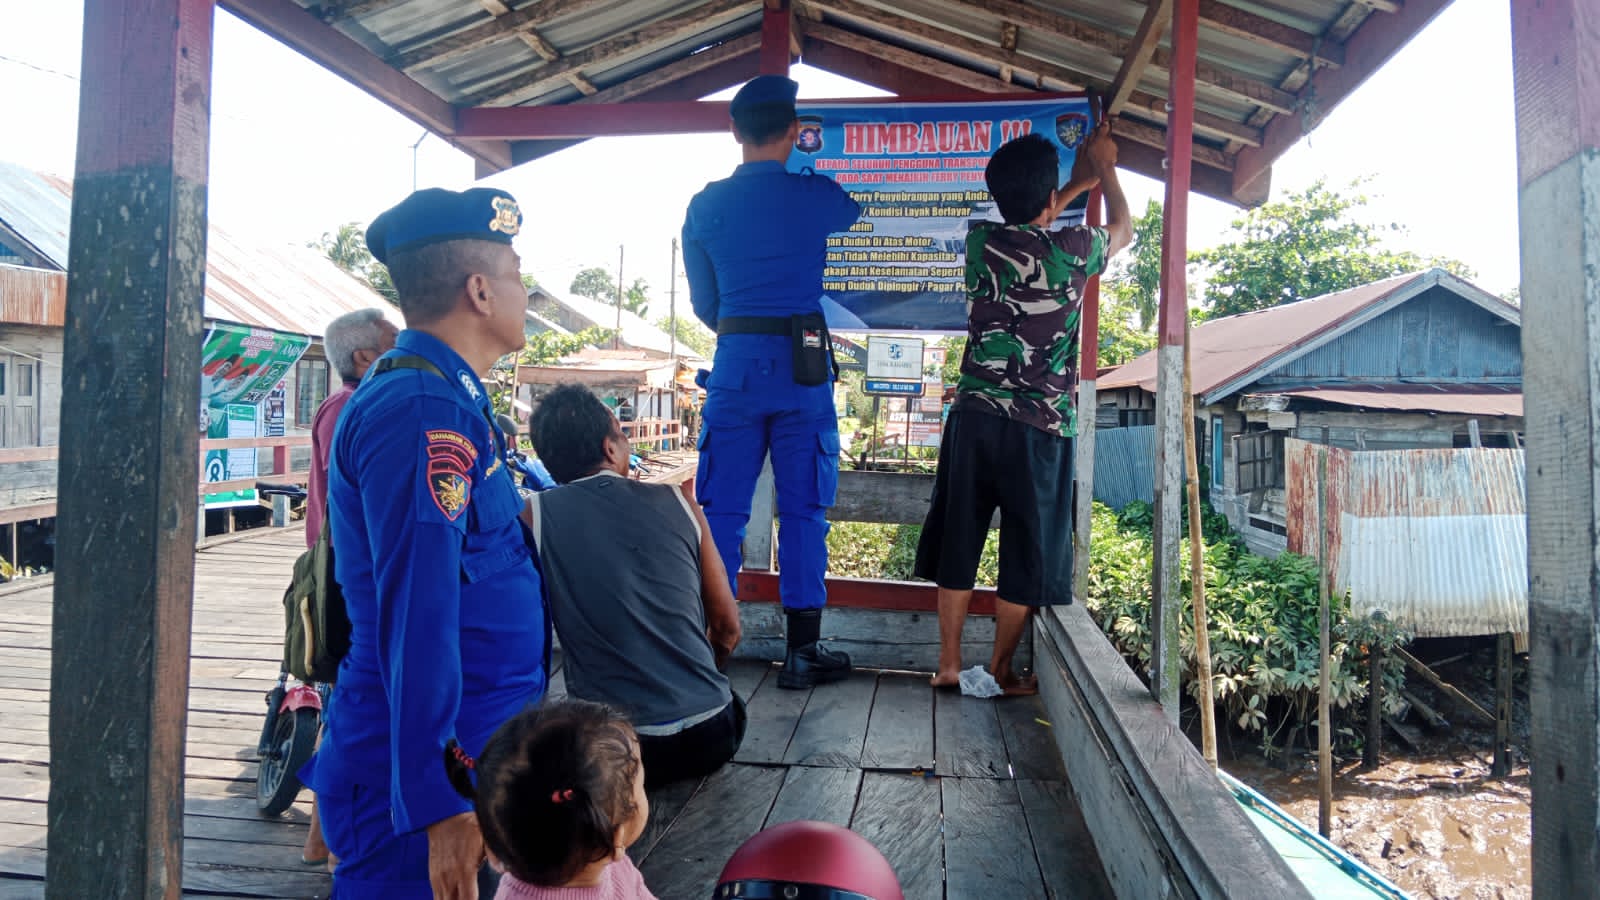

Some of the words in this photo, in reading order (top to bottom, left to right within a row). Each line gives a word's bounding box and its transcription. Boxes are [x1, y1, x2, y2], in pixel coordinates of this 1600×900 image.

[845, 122, 991, 154] HIMBAUAN
[816, 159, 849, 169] KEPADA
[851, 159, 890, 169] SELURUH
[893, 158, 940, 168] PENGGUNA
[836, 173, 859, 183] PADA
[861, 173, 882, 183] SAAT
[931, 171, 958, 182] FERRY
[941, 192, 963, 202] yang
[965, 191, 988, 200] Anda
[869, 207, 902, 216] Kondisi
[904, 207, 930, 217] Layak
[932, 207, 971, 217] Berlayar
[843, 237, 871, 246] Duduk
[873, 237, 881, 246] Di
[883, 237, 903, 246] Atas
[904, 237, 931, 246] Motor
[844, 252, 868, 261] Tidak
[870, 252, 909, 261] Melebihi
[911, 252, 956, 262] Kapasitas
[850, 267, 867, 275] Alat
[870, 267, 928, 276] Keselamatan
[931, 267, 964, 277] Seperti
[848, 281, 875, 290] Duduk
[878, 282, 919, 292] Dipinggir
[927, 282, 954, 292] Pagar
